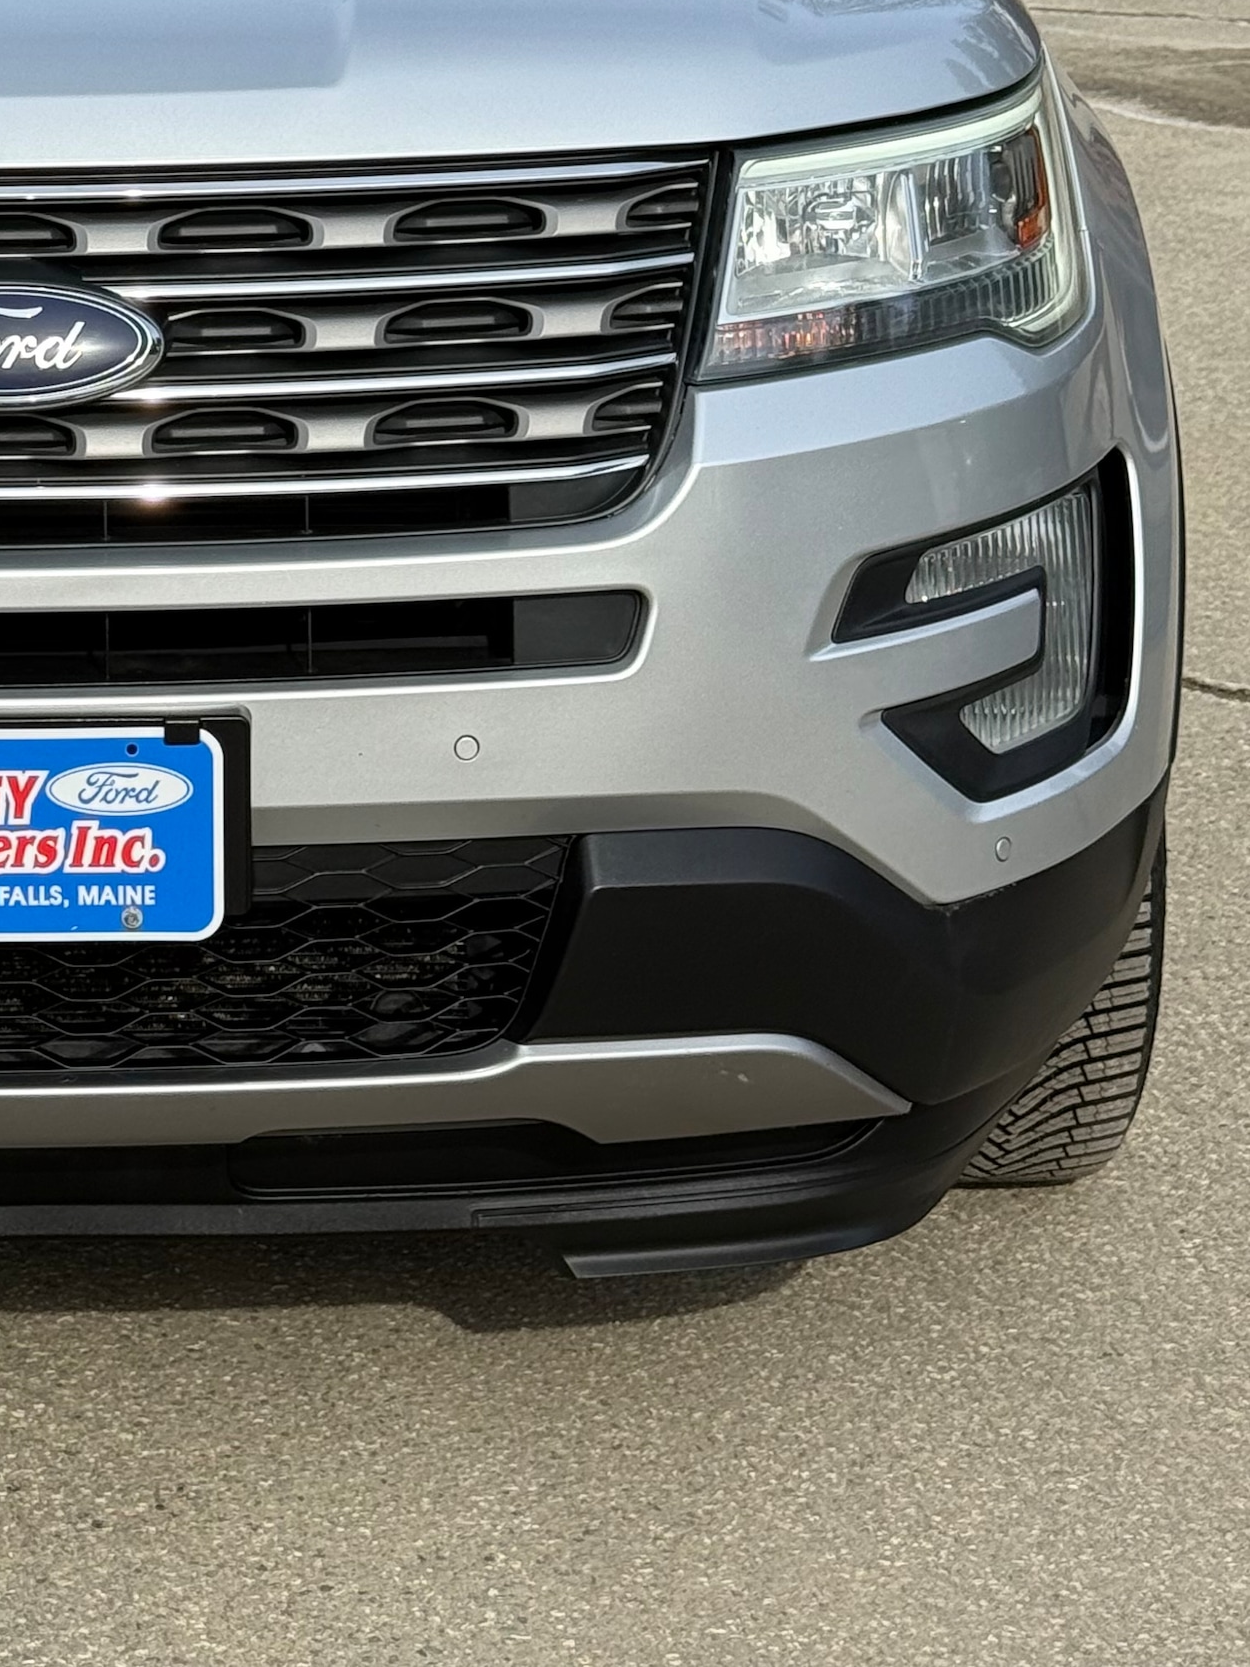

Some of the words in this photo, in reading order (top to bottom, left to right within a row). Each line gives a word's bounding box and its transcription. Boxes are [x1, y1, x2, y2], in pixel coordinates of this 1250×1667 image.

[77, 771, 161, 805] Ford
[68, 825, 161, 869] Inc.
[77, 885, 156, 906] MAINE
